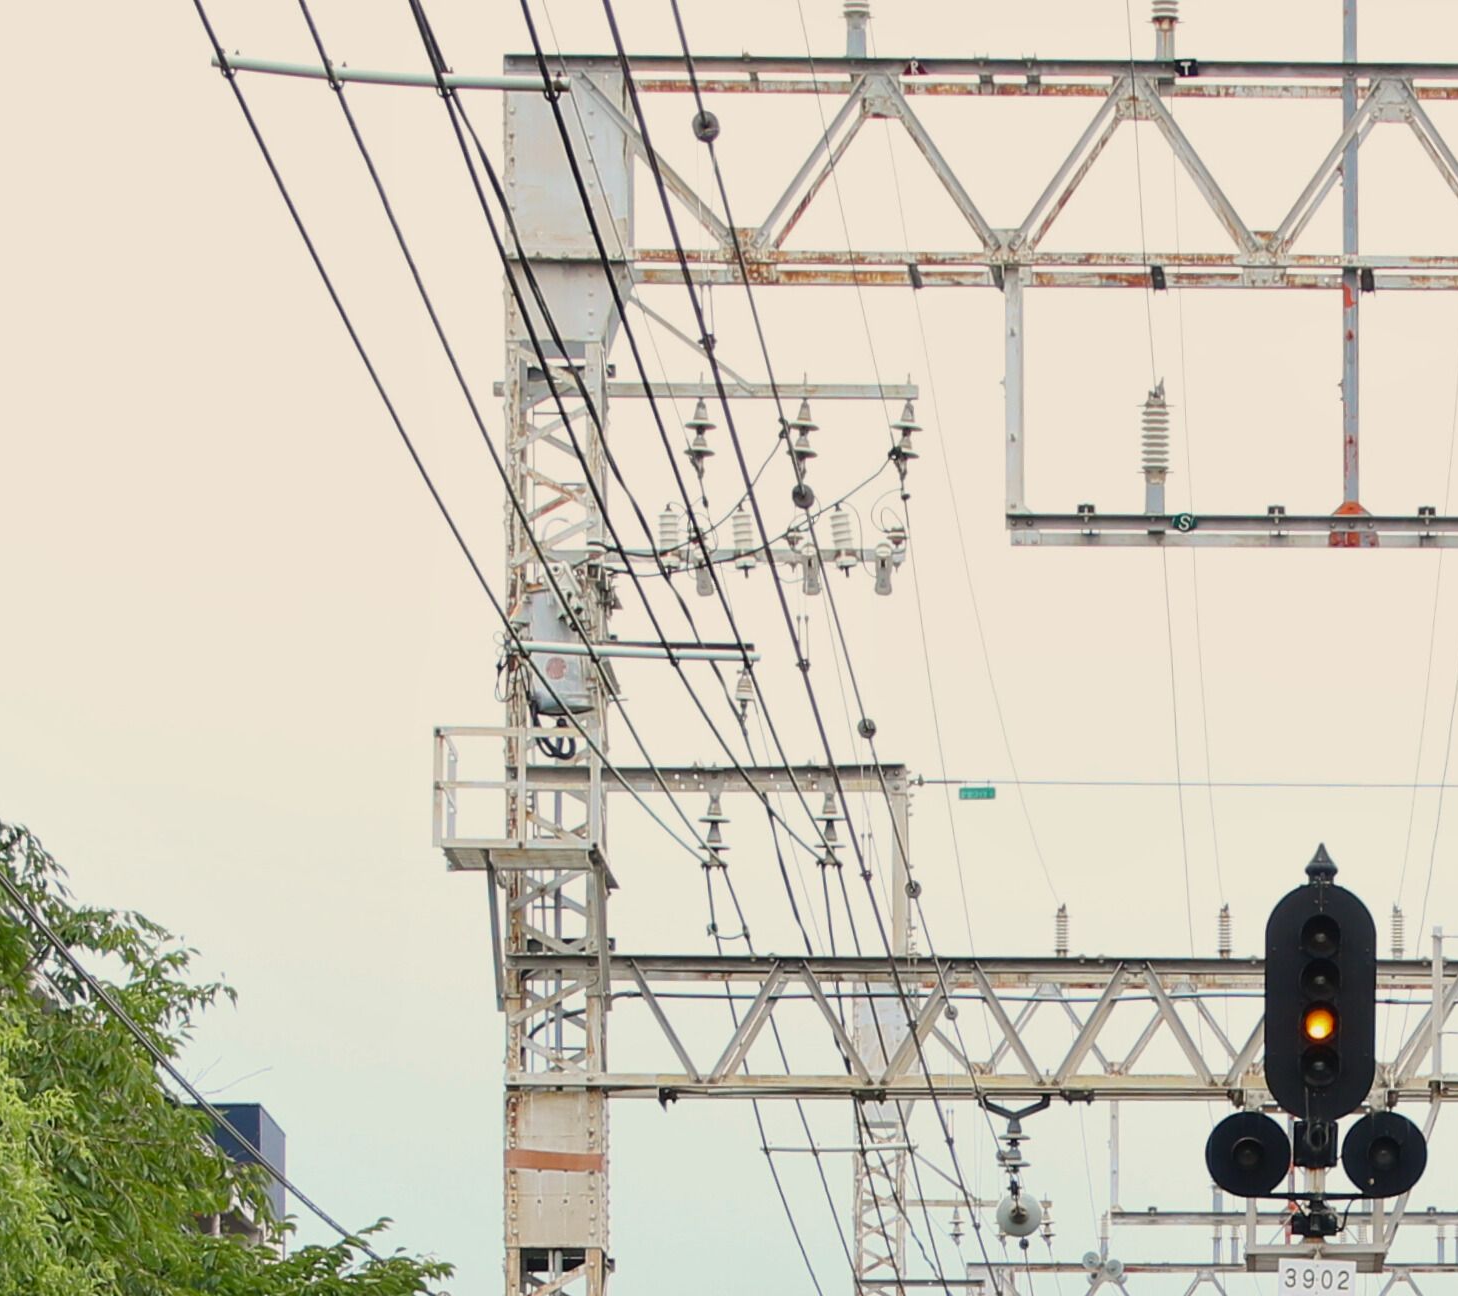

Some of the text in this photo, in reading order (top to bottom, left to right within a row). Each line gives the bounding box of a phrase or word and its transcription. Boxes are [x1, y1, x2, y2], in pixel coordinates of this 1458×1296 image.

[1180, 62, 1192, 76] T
[1178, 515, 1190, 531] S
[1284, 1268, 1350, 1290] 3902
